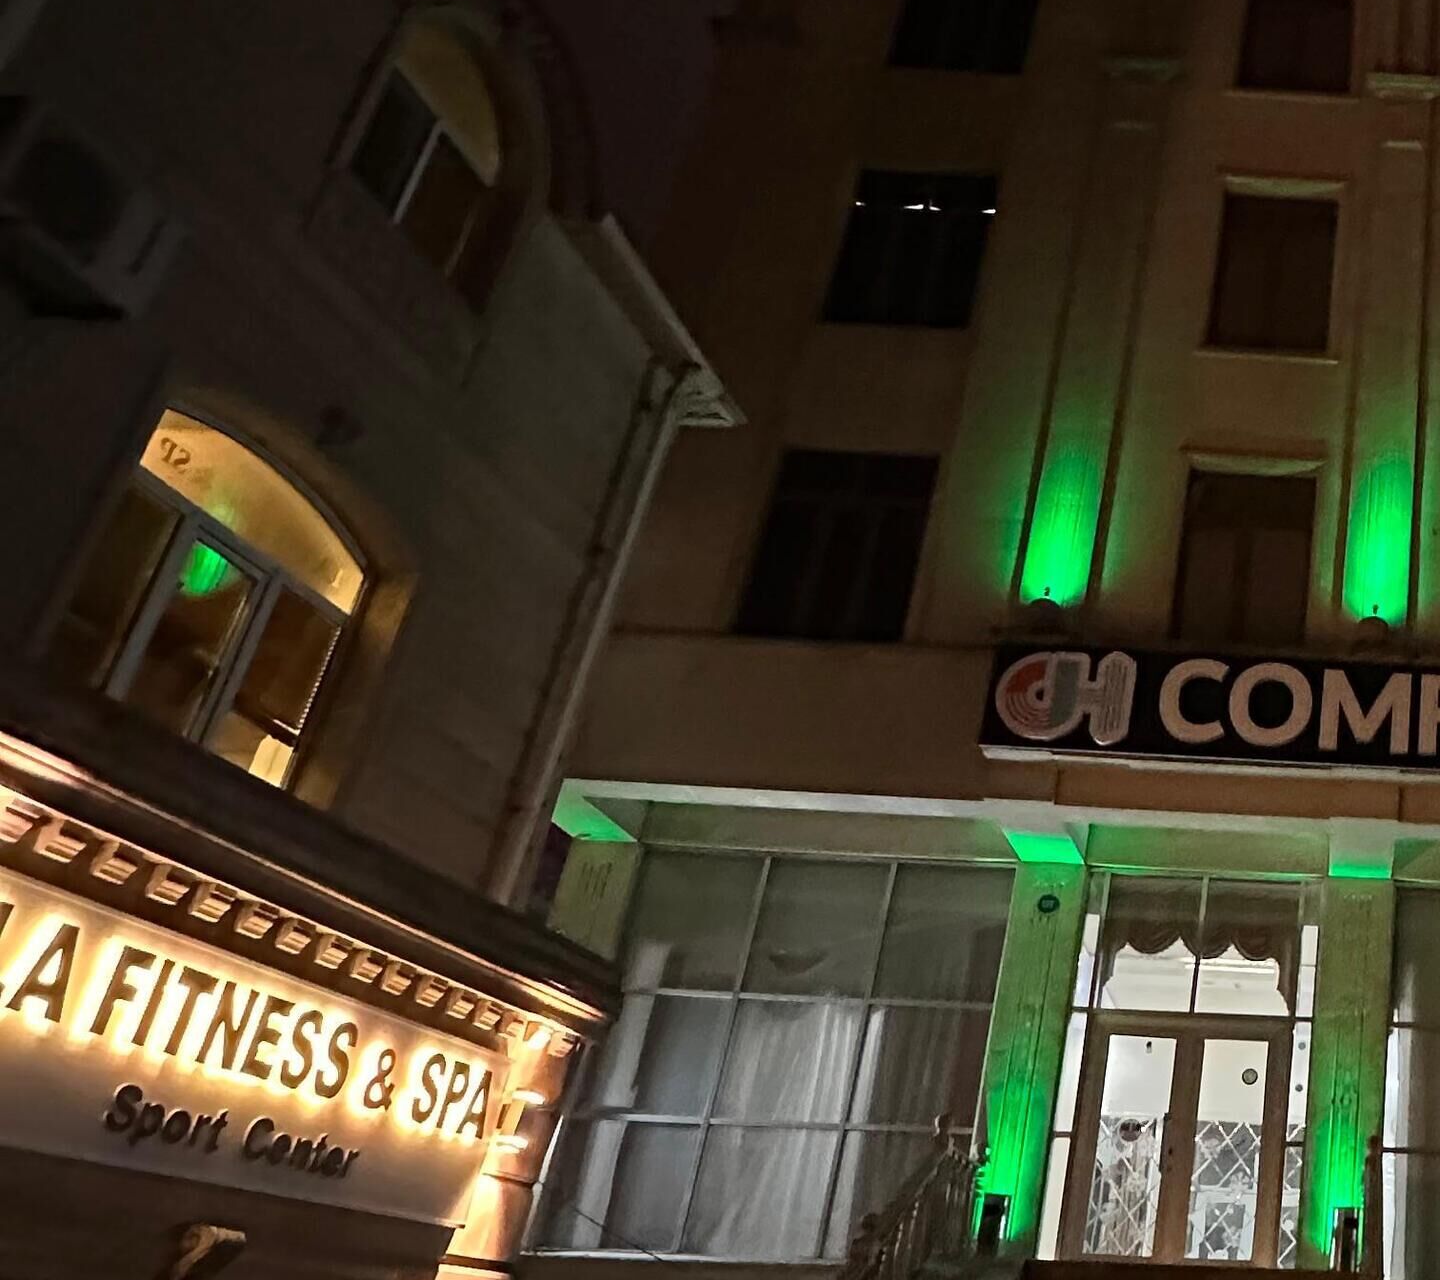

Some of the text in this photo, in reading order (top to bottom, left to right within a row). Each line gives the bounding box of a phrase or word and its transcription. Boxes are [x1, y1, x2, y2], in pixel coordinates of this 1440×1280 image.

[0, 901, 493, 1140] A FITNESS & SPA
[104, 1083, 360, 1180] Sport Center
